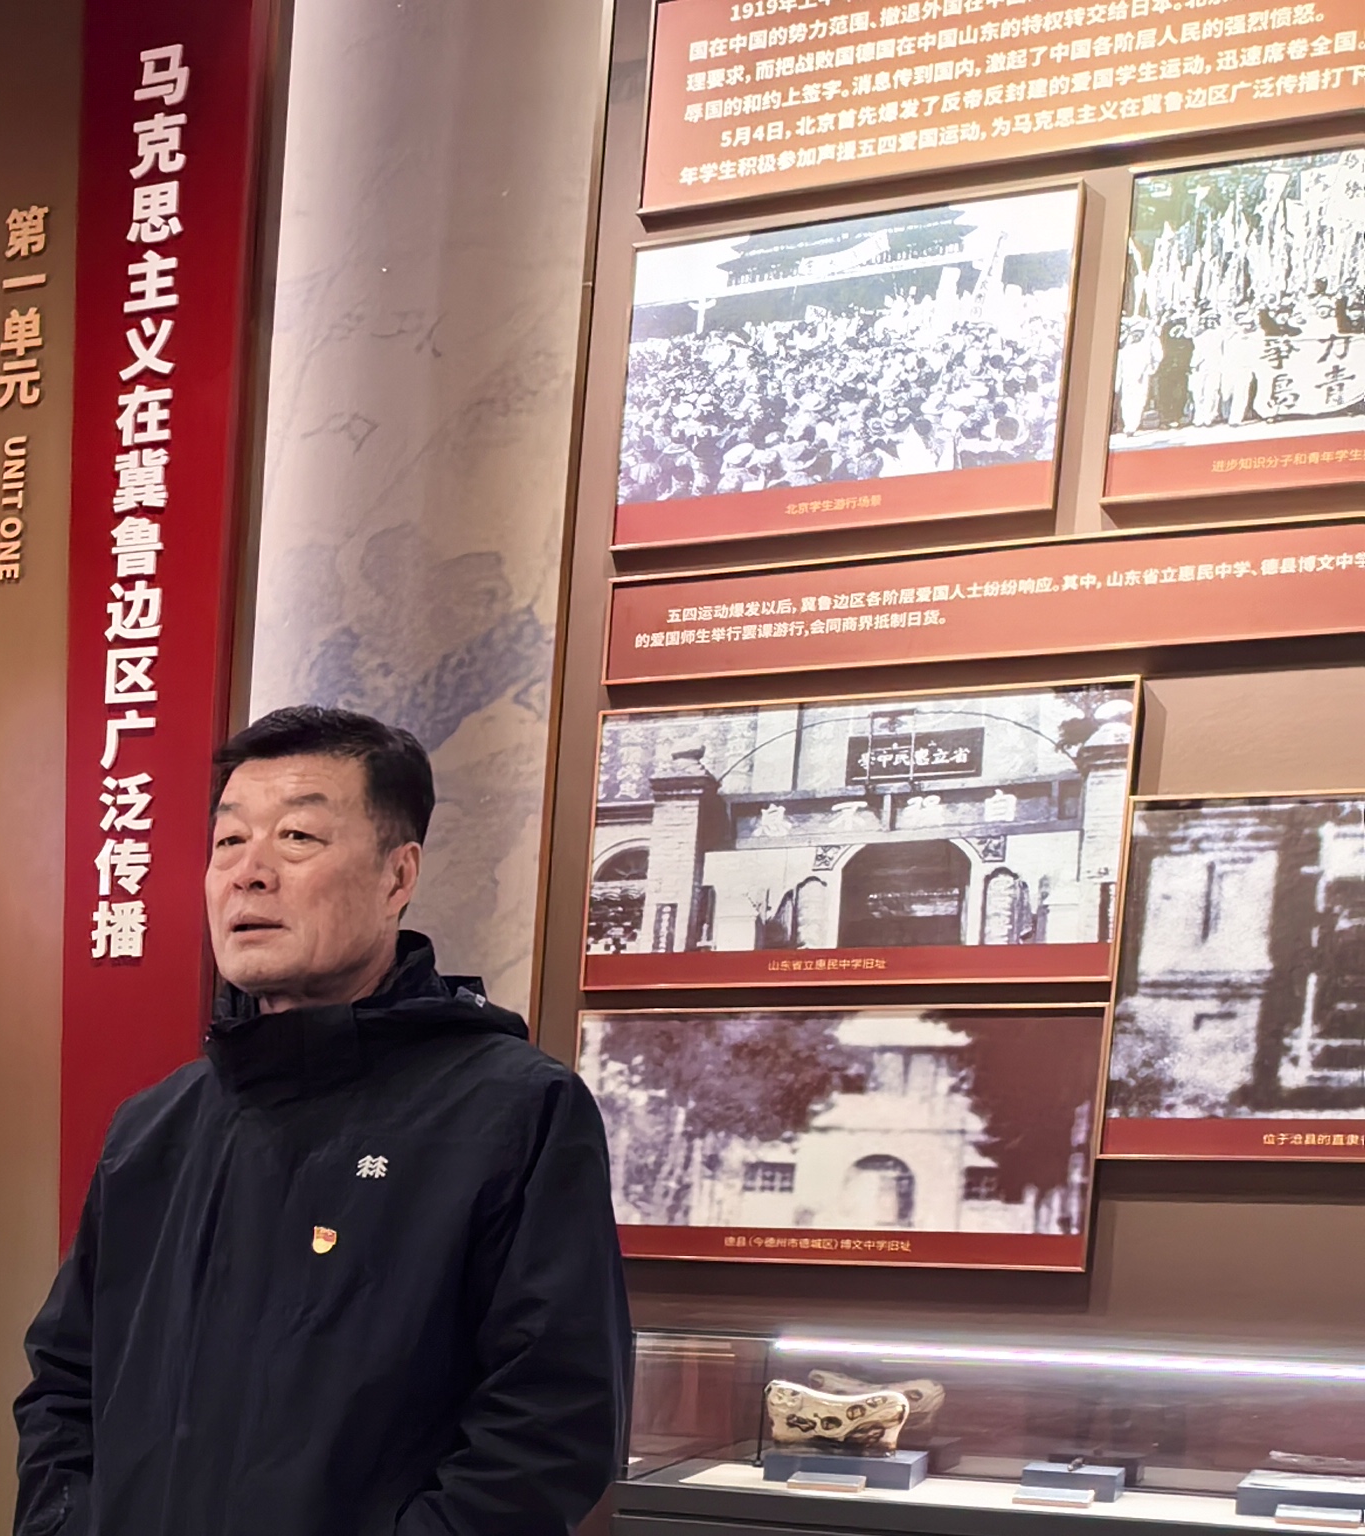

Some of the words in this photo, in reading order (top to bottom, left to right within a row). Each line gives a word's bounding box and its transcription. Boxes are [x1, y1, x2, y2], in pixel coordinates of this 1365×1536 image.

[1, 435, 28, 511] UNIT
[1211, 449, 1365, 472] 进步知识分子和青年学生
[91, 43, 191, 961] 马克思主义在冀鲁边区广泛传播
